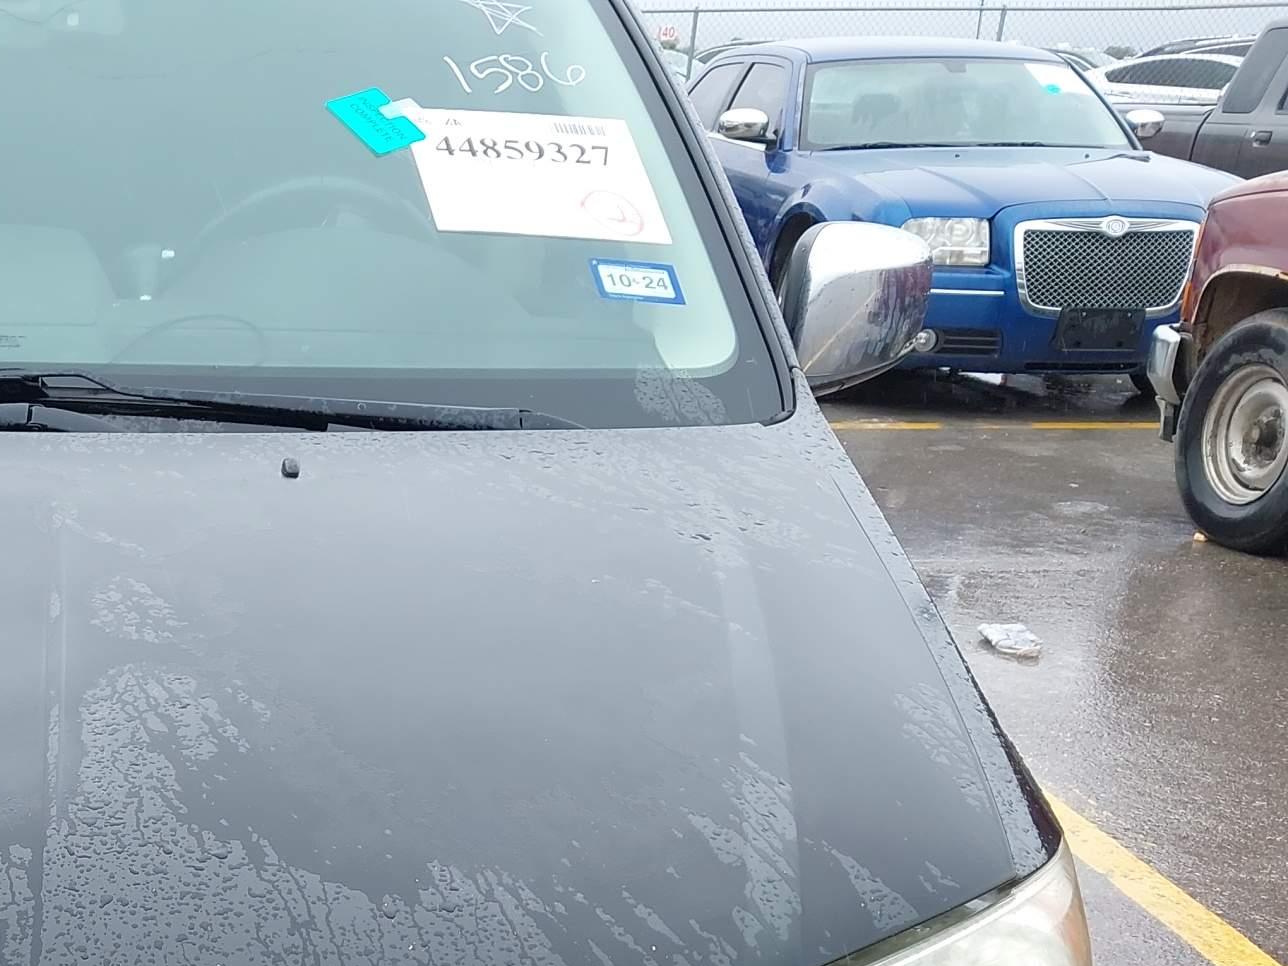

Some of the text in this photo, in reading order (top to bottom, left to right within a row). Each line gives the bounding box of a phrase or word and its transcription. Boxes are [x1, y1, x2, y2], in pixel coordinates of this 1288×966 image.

[443, 51, 586, 93] 1586
[350, 103, 393, 143] COMPLETE
[435, 136, 608, 166] 44859327
